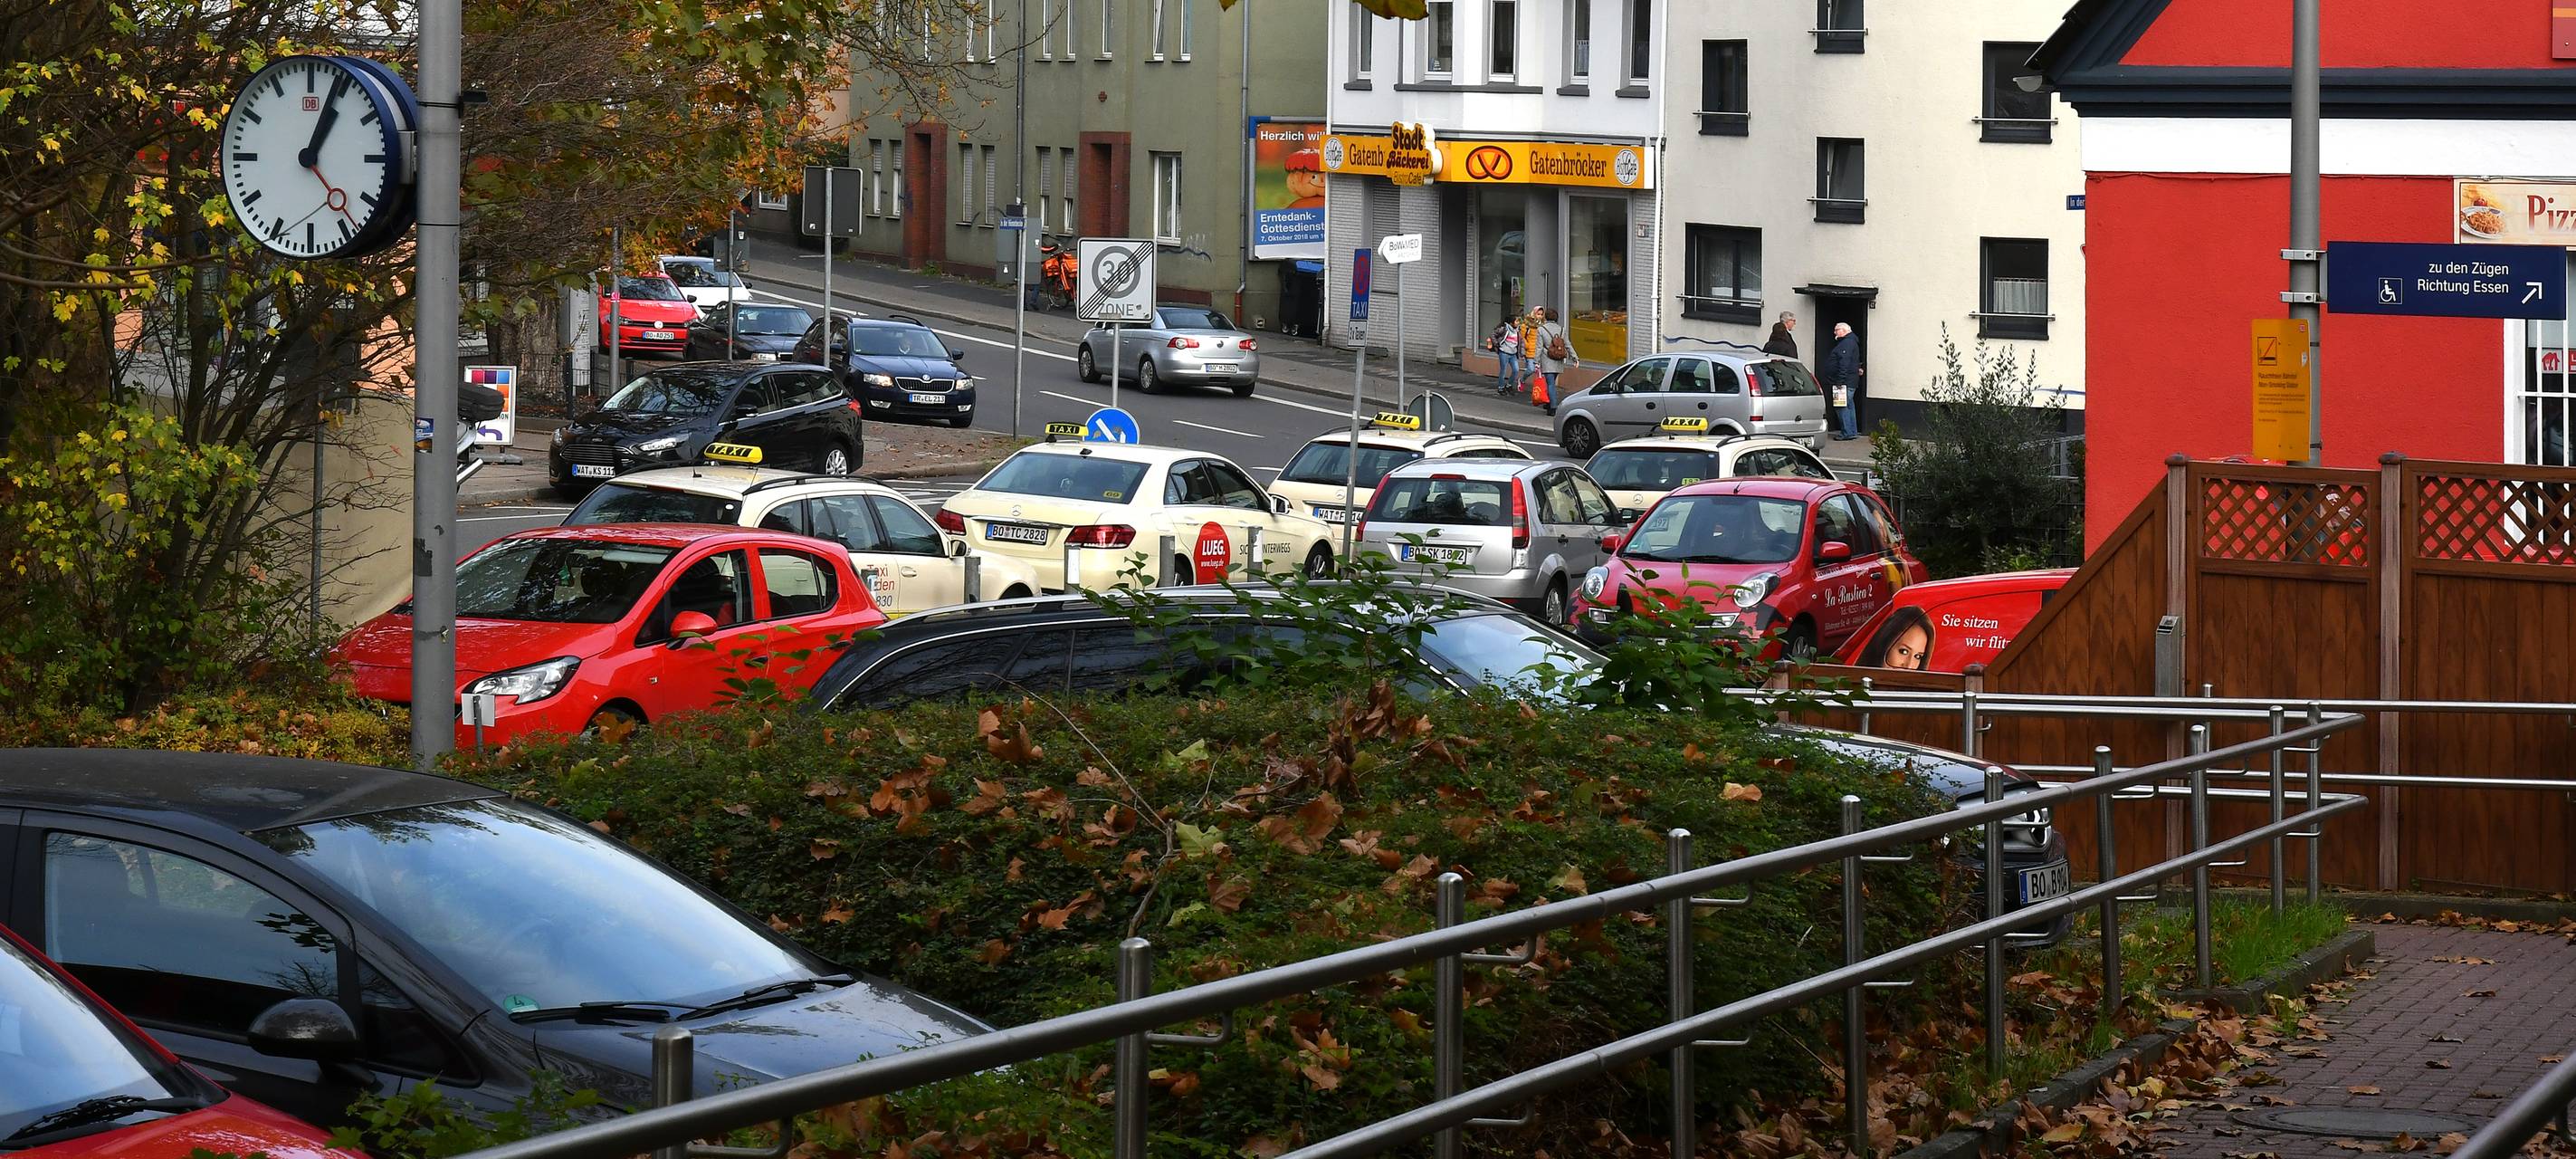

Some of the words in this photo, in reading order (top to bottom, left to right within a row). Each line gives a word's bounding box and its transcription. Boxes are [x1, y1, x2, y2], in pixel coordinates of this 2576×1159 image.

[305, 99, 317, 109] DB
[1260, 130, 1304, 141] Herzlich
[1392, 124, 1424, 151] Stadt
[1349, 143, 1383, 168] Gatenb
[1386, 150, 1430, 170] Bäckerei
[1529, 149, 1608, 178] Gatenbröcker
[1260, 212, 1316, 223] Erntedank-
[1260, 222, 1325, 234] Gottesdienst
[1102, 260, 1131, 284] 30
[2428, 263, 2443, 273] zu
[2446, 262, 2468, 274] den
[2472, 261, 2509, 277] Zügen
[2418, 278, 2470, 295] Richtung
[2474, 280, 2509, 293] Essen
[1098, 303, 1134, 316] ZONE
[1351, 301, 1369, 318] TAXI
[1379, 413, 1409, 424] TAXI
[1667, 418, 1699, 426] TAXI
[1053, 426, 1077, 434] TAXI
[711, 445, 747, 457] TAXI
[1318, 508, 1337, 521] WAT
[992, 525, 1005, 536] BO
[1011, 527, 1022, 538] TC
[1024, 528, 1045, 541] 2828
[1202, 540, 1226, 556] LUEG.
[1263, 542, 1291, 554] NTERWEGS
[1408, 547, 1421, 558] BO
[1427, 548, 1439, 560] SK
[1441, 549, 1465, 560] 182
[1824, 588, 1836, 608] La
[1837, 583, 1866, 605] Rustica
[1941, 613, 1961, 627] Sie
[1963, 615, 1999, 629] sitzen
[1965, 634, 1986, 647] wir
[2031, 871, 2046, 899] BO
